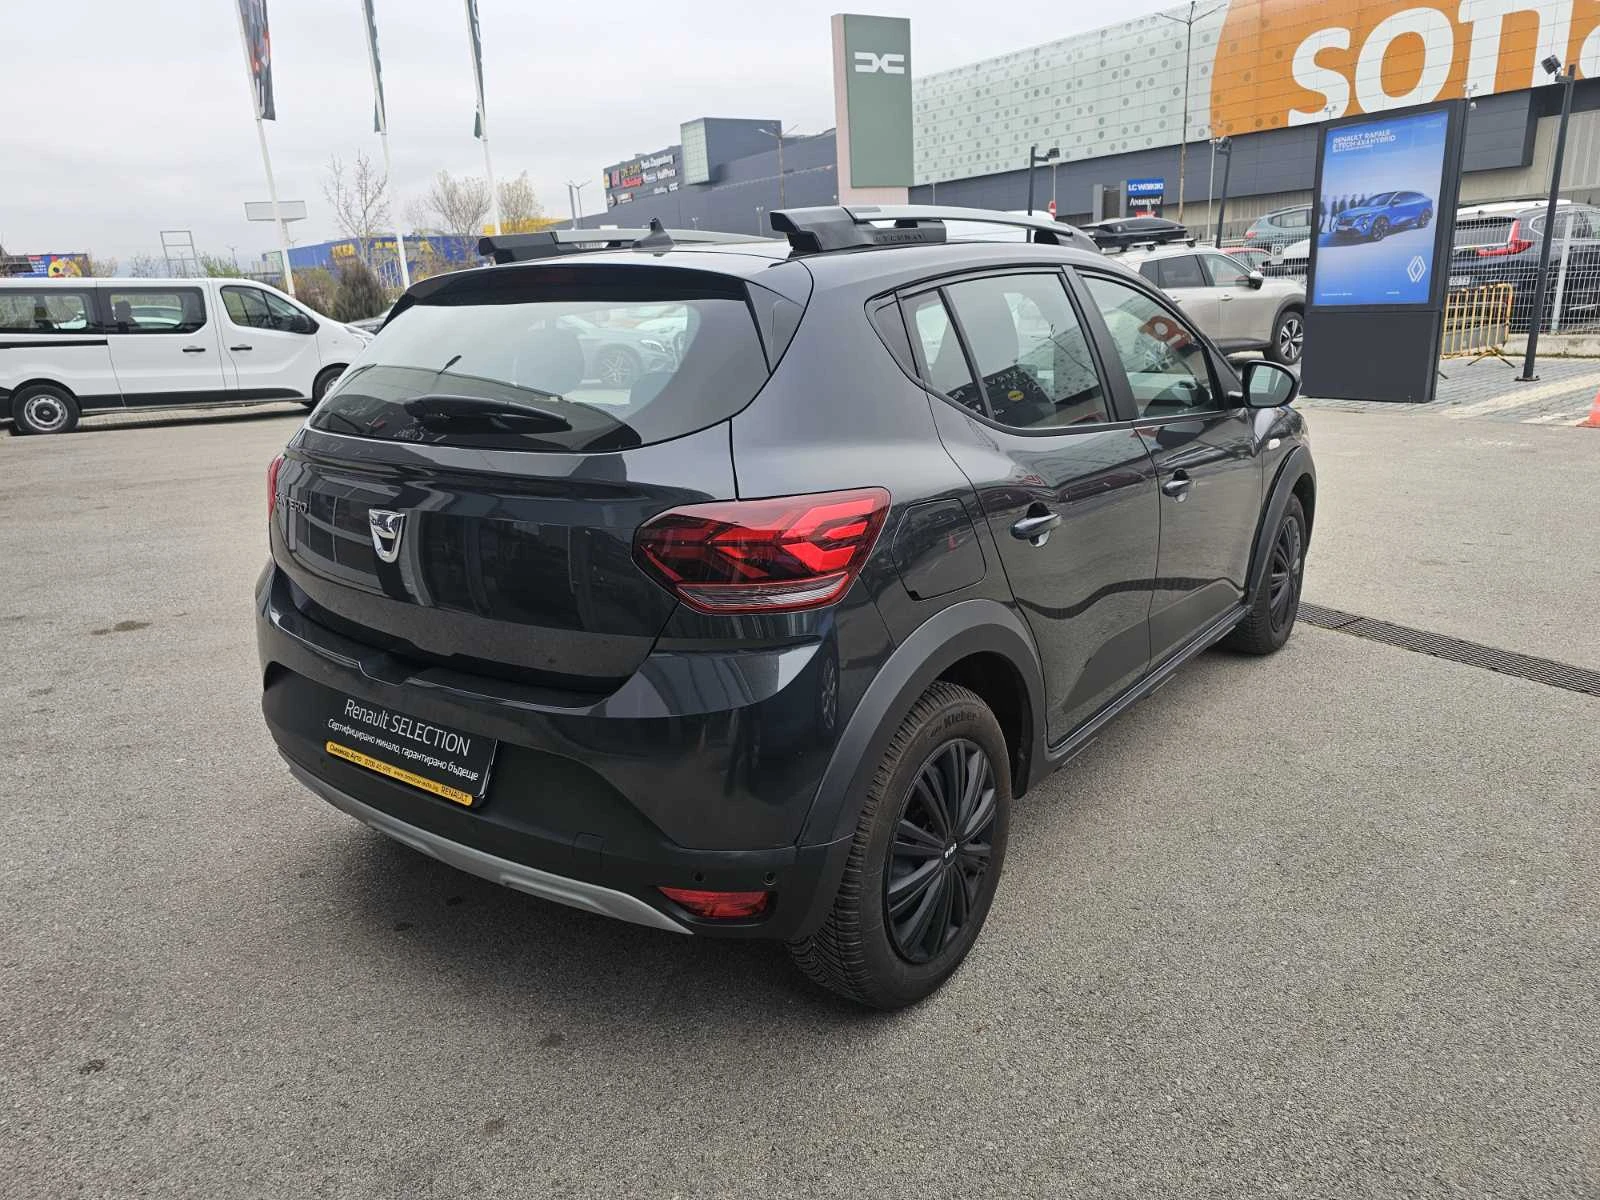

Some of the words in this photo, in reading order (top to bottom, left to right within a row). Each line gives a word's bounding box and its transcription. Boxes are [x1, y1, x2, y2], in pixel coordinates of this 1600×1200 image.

[1287, 0, 1600, 127] son
[331, 243, 356, 259] IKEA
[327, 718, 375, 745] Сертифицирано
[375, 735, 401, 756] минало,
[401, 746, 447, 771] гарантирано
[447, 760, 480, 782] бъдеще
[344, 698, 390, 731] Renault
[390, 714, 472, 758] SELECTION
[441, 784, 470, 803] RENAULT
